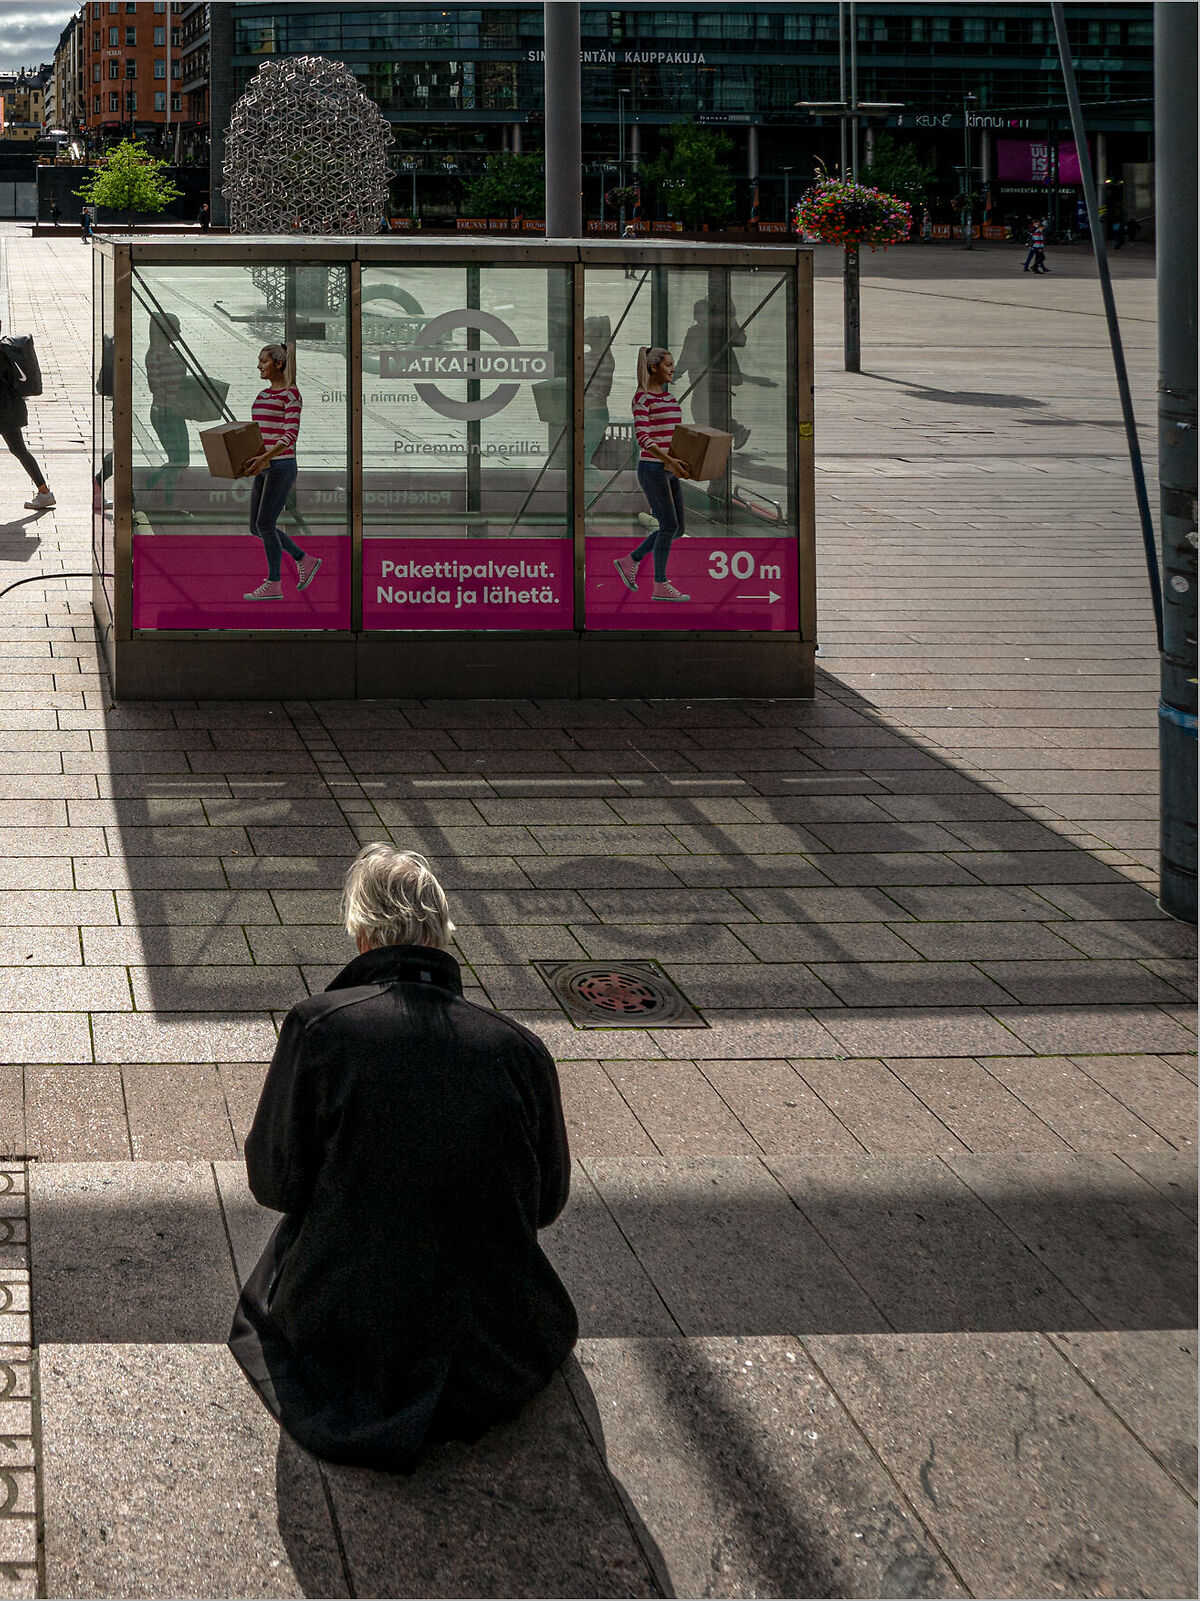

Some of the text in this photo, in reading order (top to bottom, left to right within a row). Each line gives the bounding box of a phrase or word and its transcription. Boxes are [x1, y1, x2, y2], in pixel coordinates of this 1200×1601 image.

[527, 50, 705, 64] SIENTÄN KAUPPAKUJA
[387, 357, 547, 373] MATKAHUOLTO
[393, 439, 541, 457] Paremmin perillä
[382, 560, 555, 581] Pakettipalvelut.
[708, 550, 781, 580] 30 m
[377, 585, 560, 609] Nouda ja lähetä.
